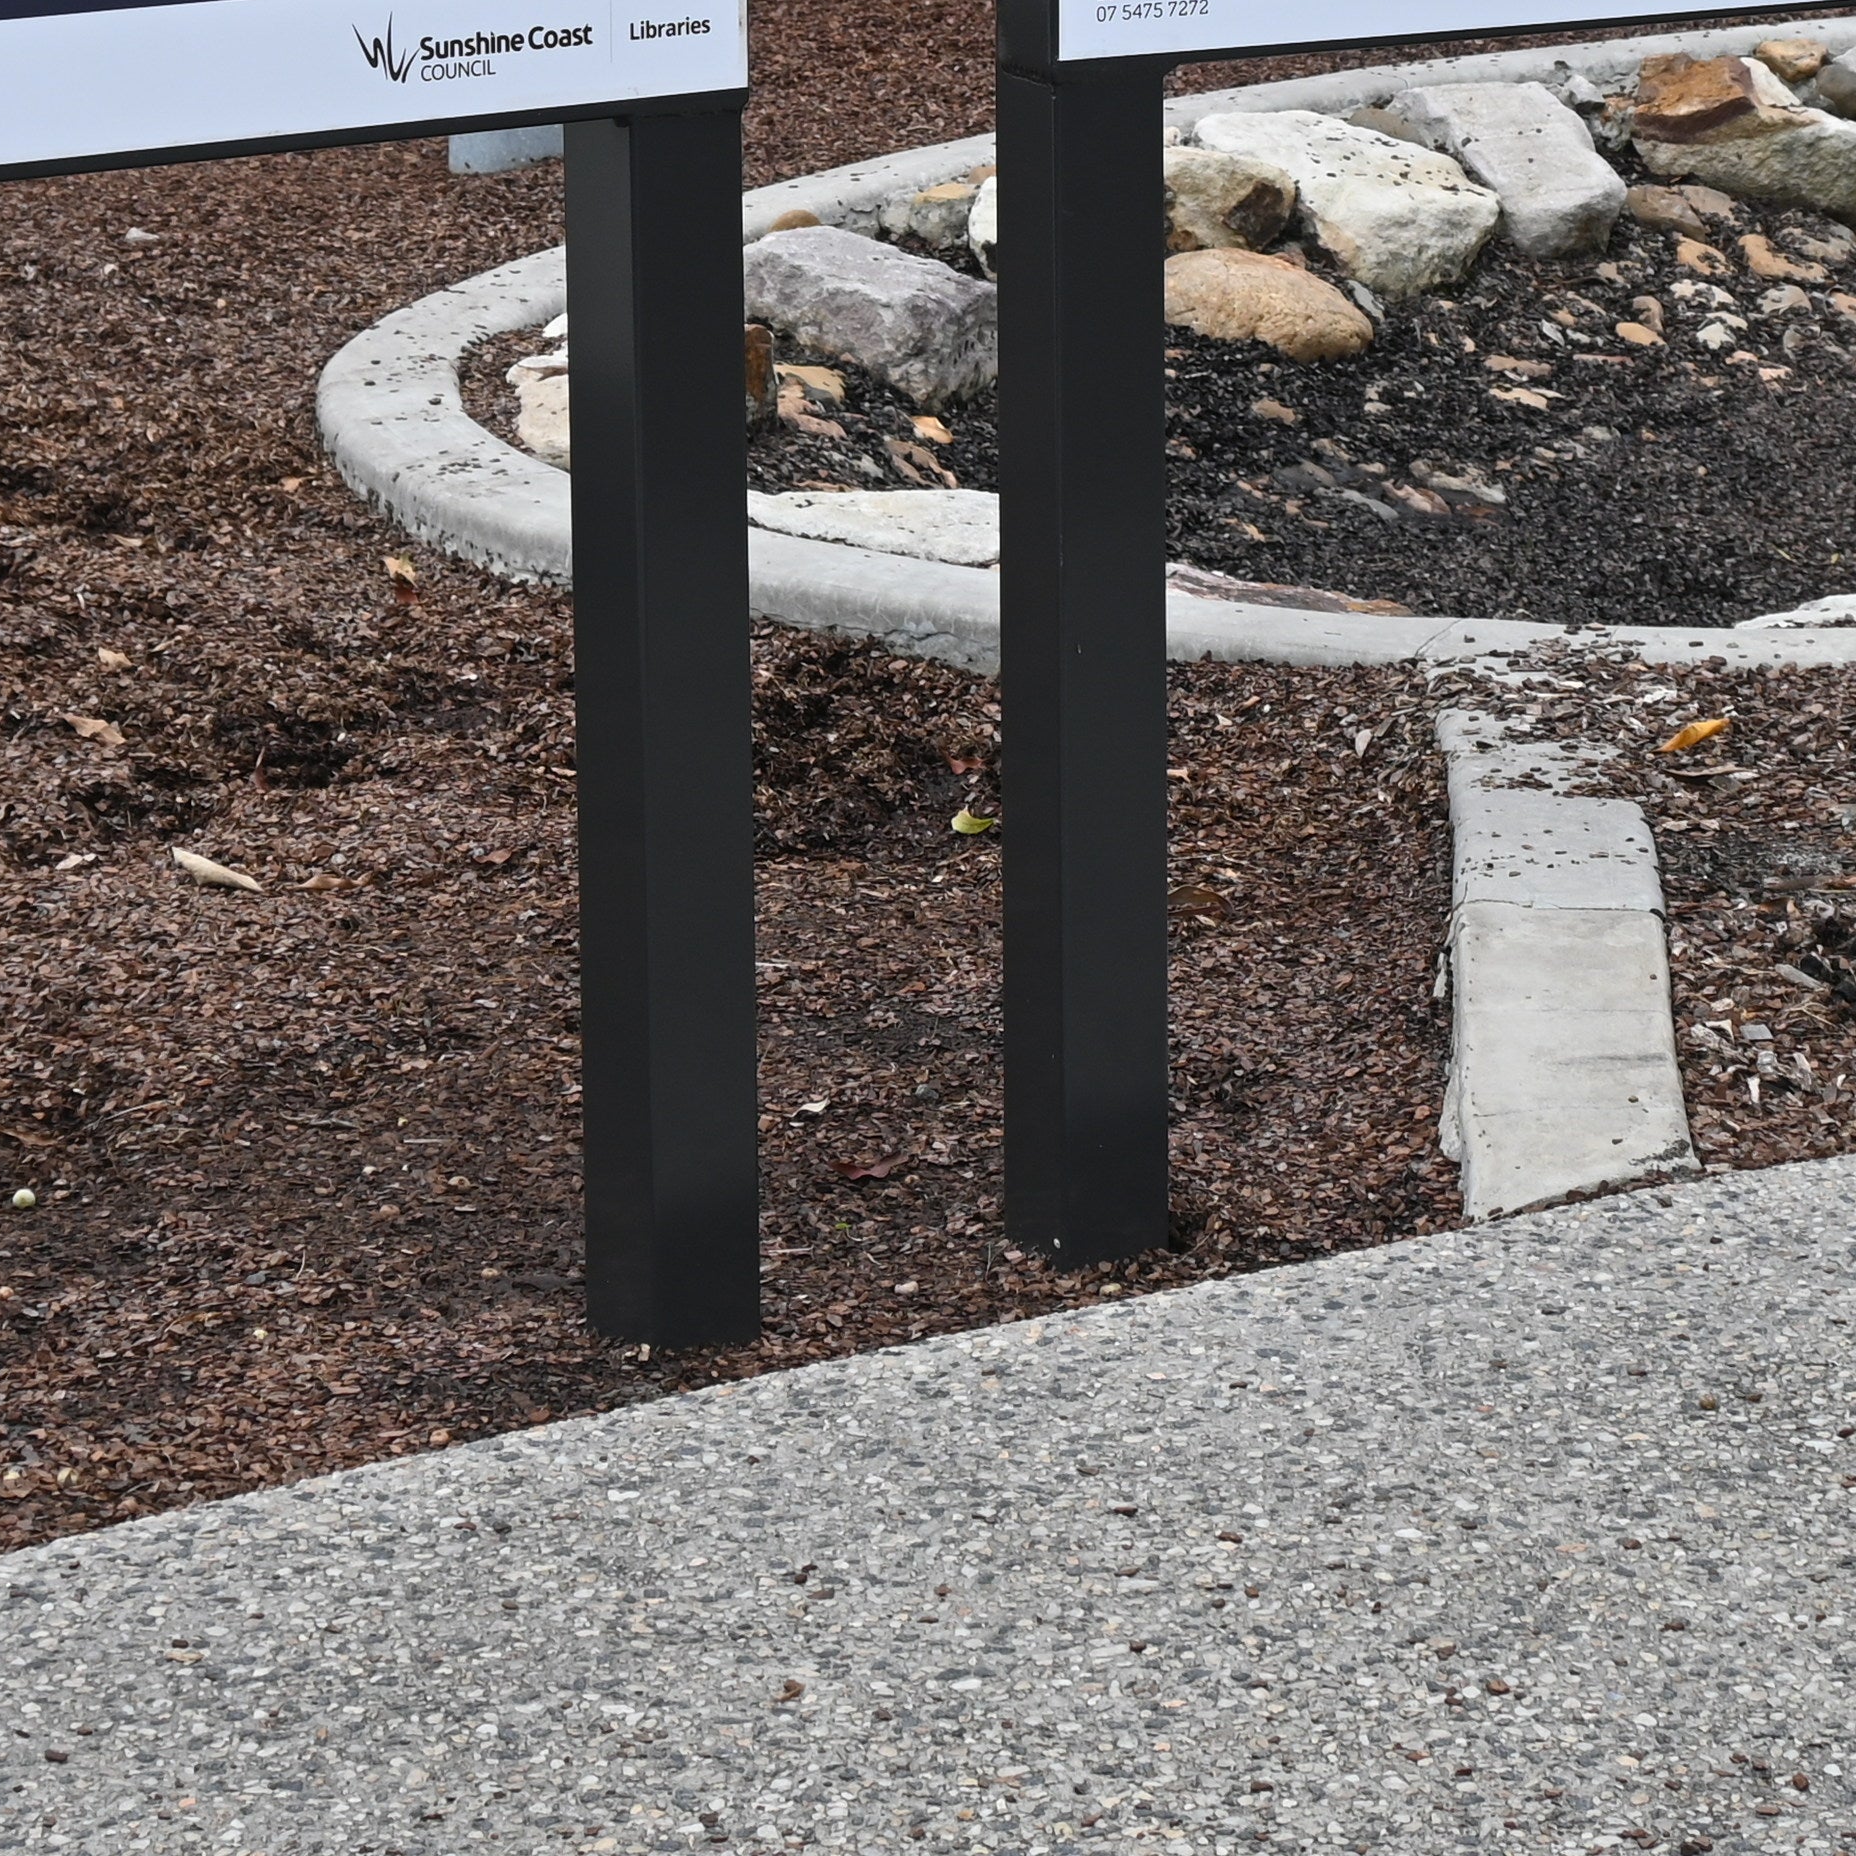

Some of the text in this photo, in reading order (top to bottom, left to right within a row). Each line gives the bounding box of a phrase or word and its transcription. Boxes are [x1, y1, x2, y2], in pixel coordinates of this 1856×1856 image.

[1096, 4, 1117, 22] 07
[1121, 1, 1163, 21] 5475
[629, 16, 711, 41] Libraries
[420, 23, 593, 61] Sunshine Coast
[420, 58, 496, 82] COUNCIL
